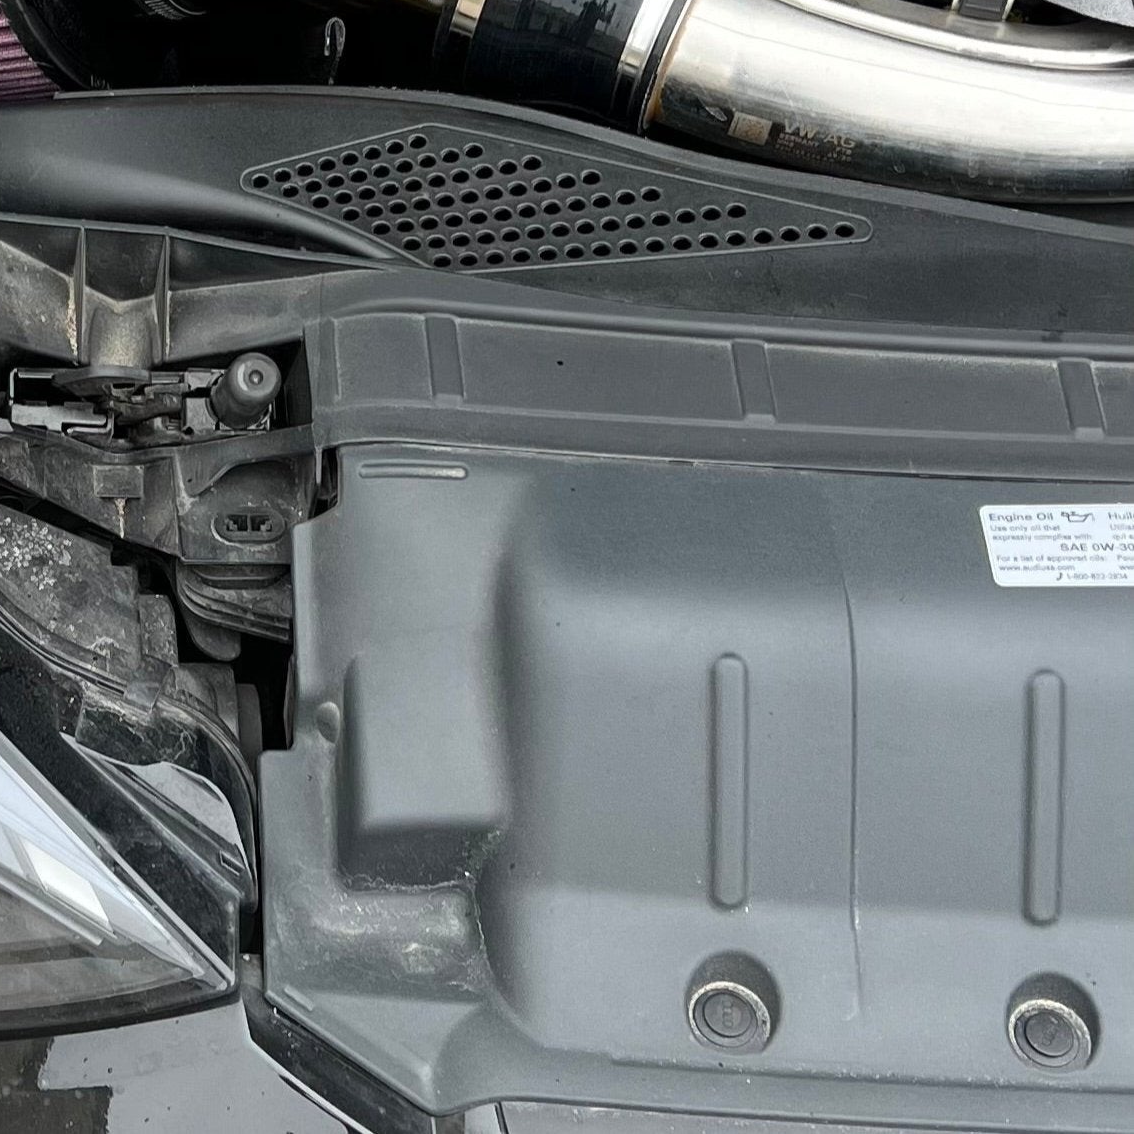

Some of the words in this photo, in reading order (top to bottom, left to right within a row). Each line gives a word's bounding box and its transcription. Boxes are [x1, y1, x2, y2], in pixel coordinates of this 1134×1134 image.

[989, 512, 1032, 522] Engine
[1036, 512, 1054, 521] Oil
[1009, 525, 1027, 533] only
[992, 534, 1032, 542] expressly
[1060, 543, 1088, 552] SAE
[1047, 554, 1087, 563] approved
